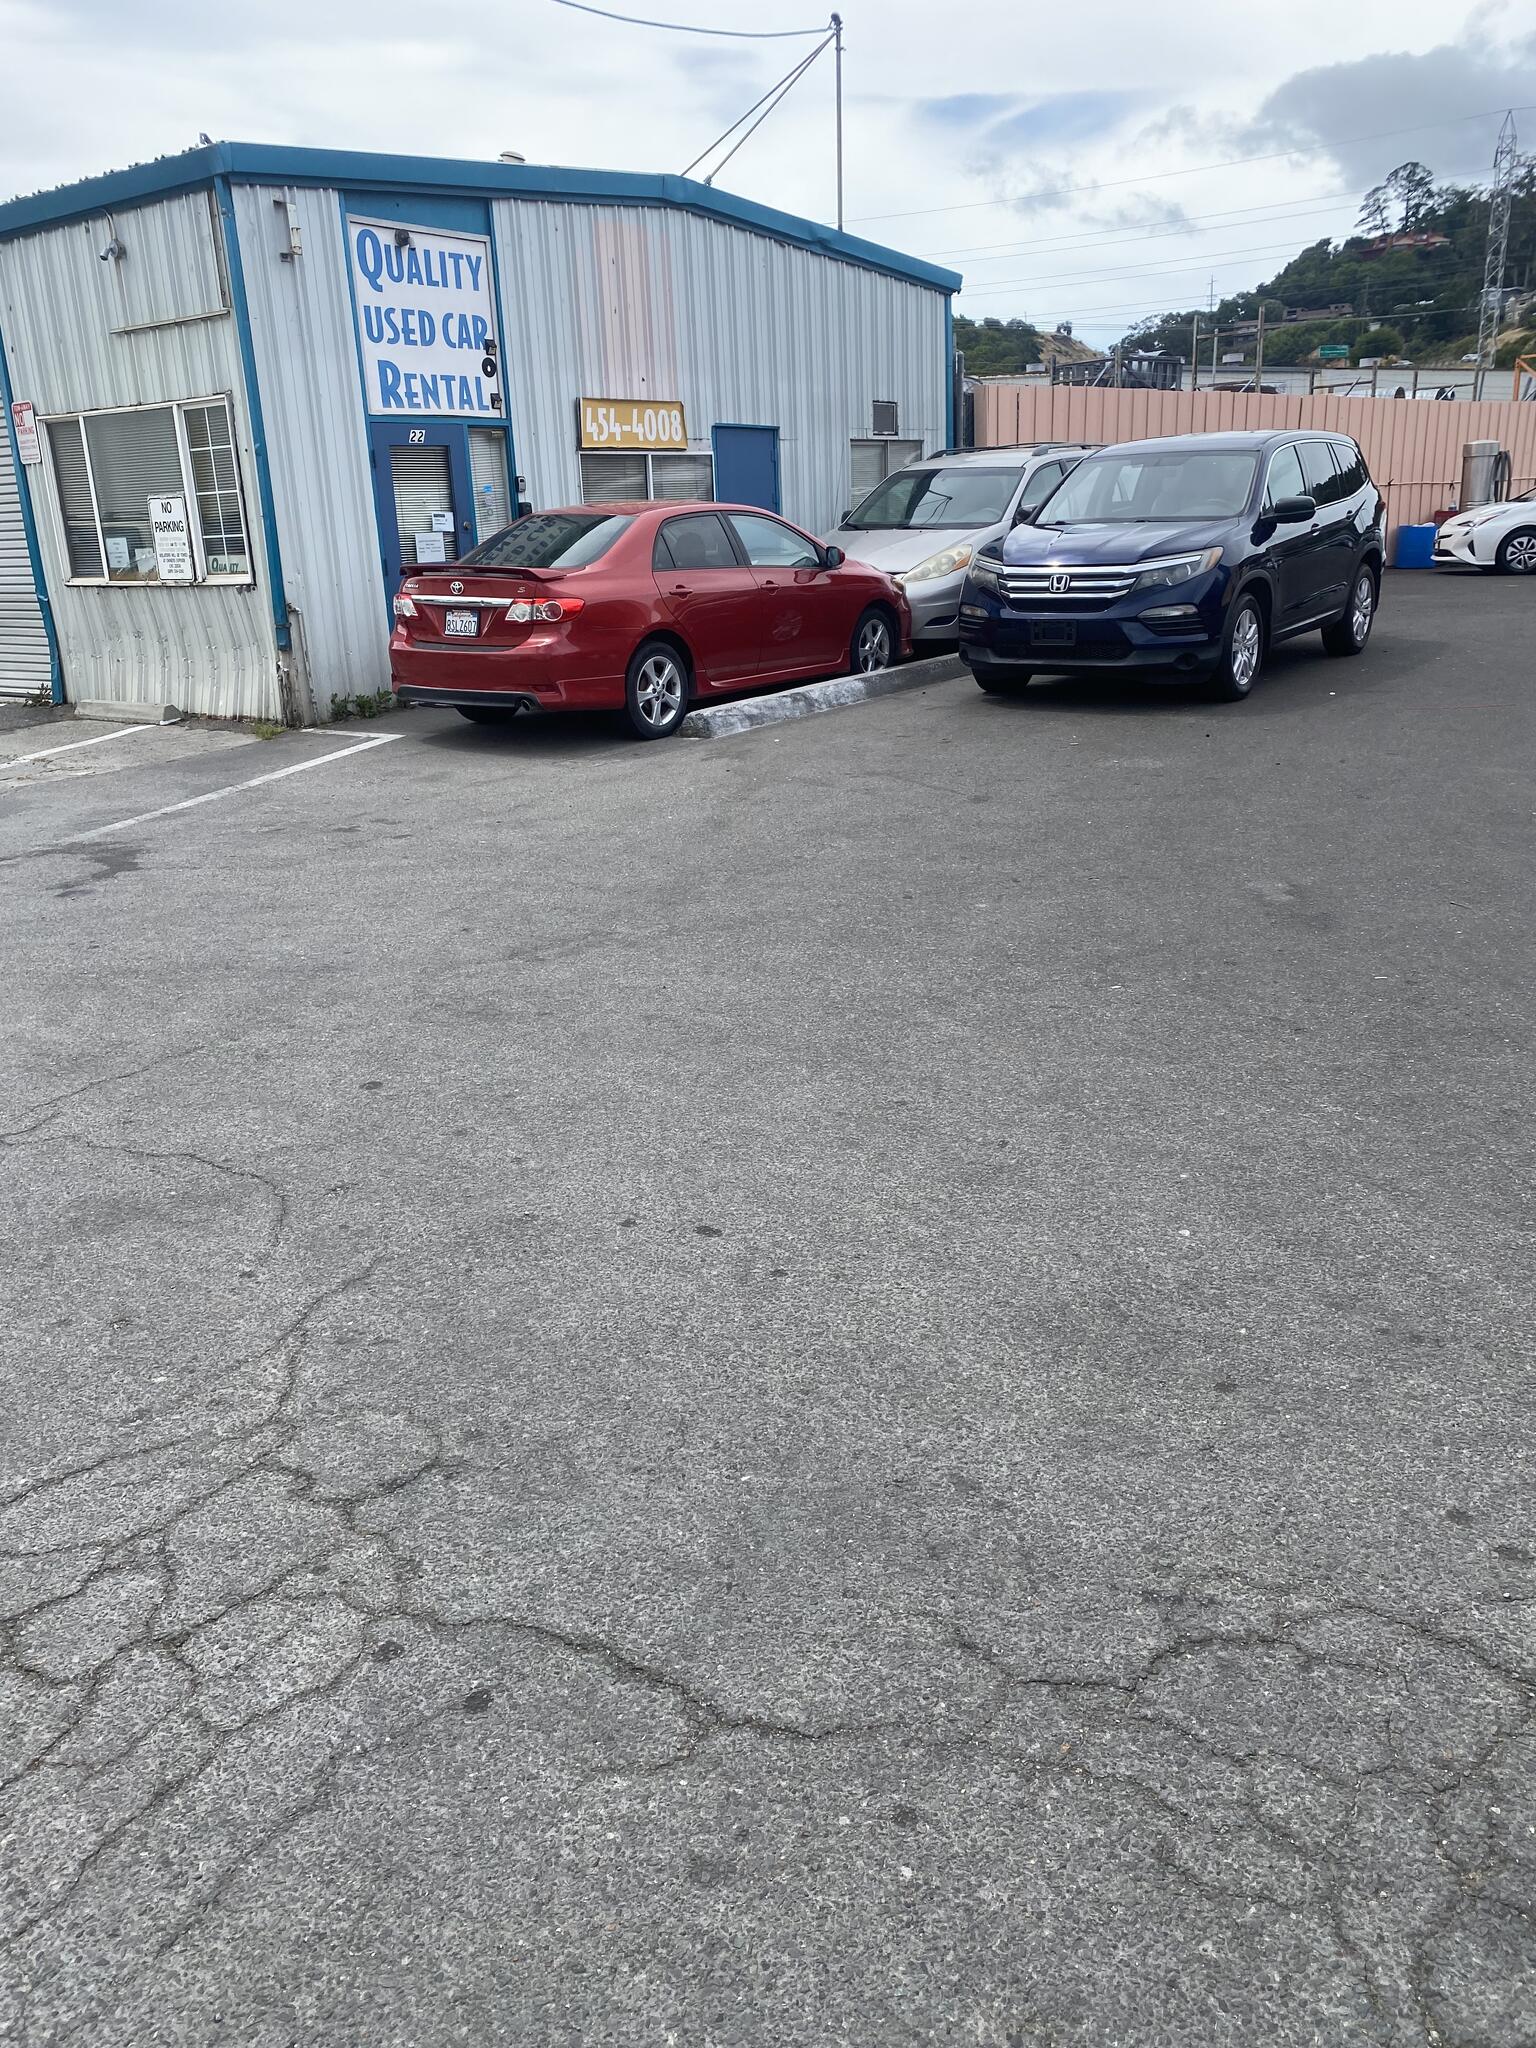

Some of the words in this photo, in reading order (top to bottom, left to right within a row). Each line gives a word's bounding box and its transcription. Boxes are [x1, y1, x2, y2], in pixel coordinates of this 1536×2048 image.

[356, 228, 482, 293] QUALITY
[363, 305, 436, 347] USED
[441, 312, 488, 350] CAR
[377, 359, 490, 411] RENTAL
[586, 407, 682, 441] 454-4008
[410, 430, 424, 443] 22
[161, 502, 172, 513] NO
[154, 520, 185, 533] PARKING
[211, 557, 239, 572] QUAITY
